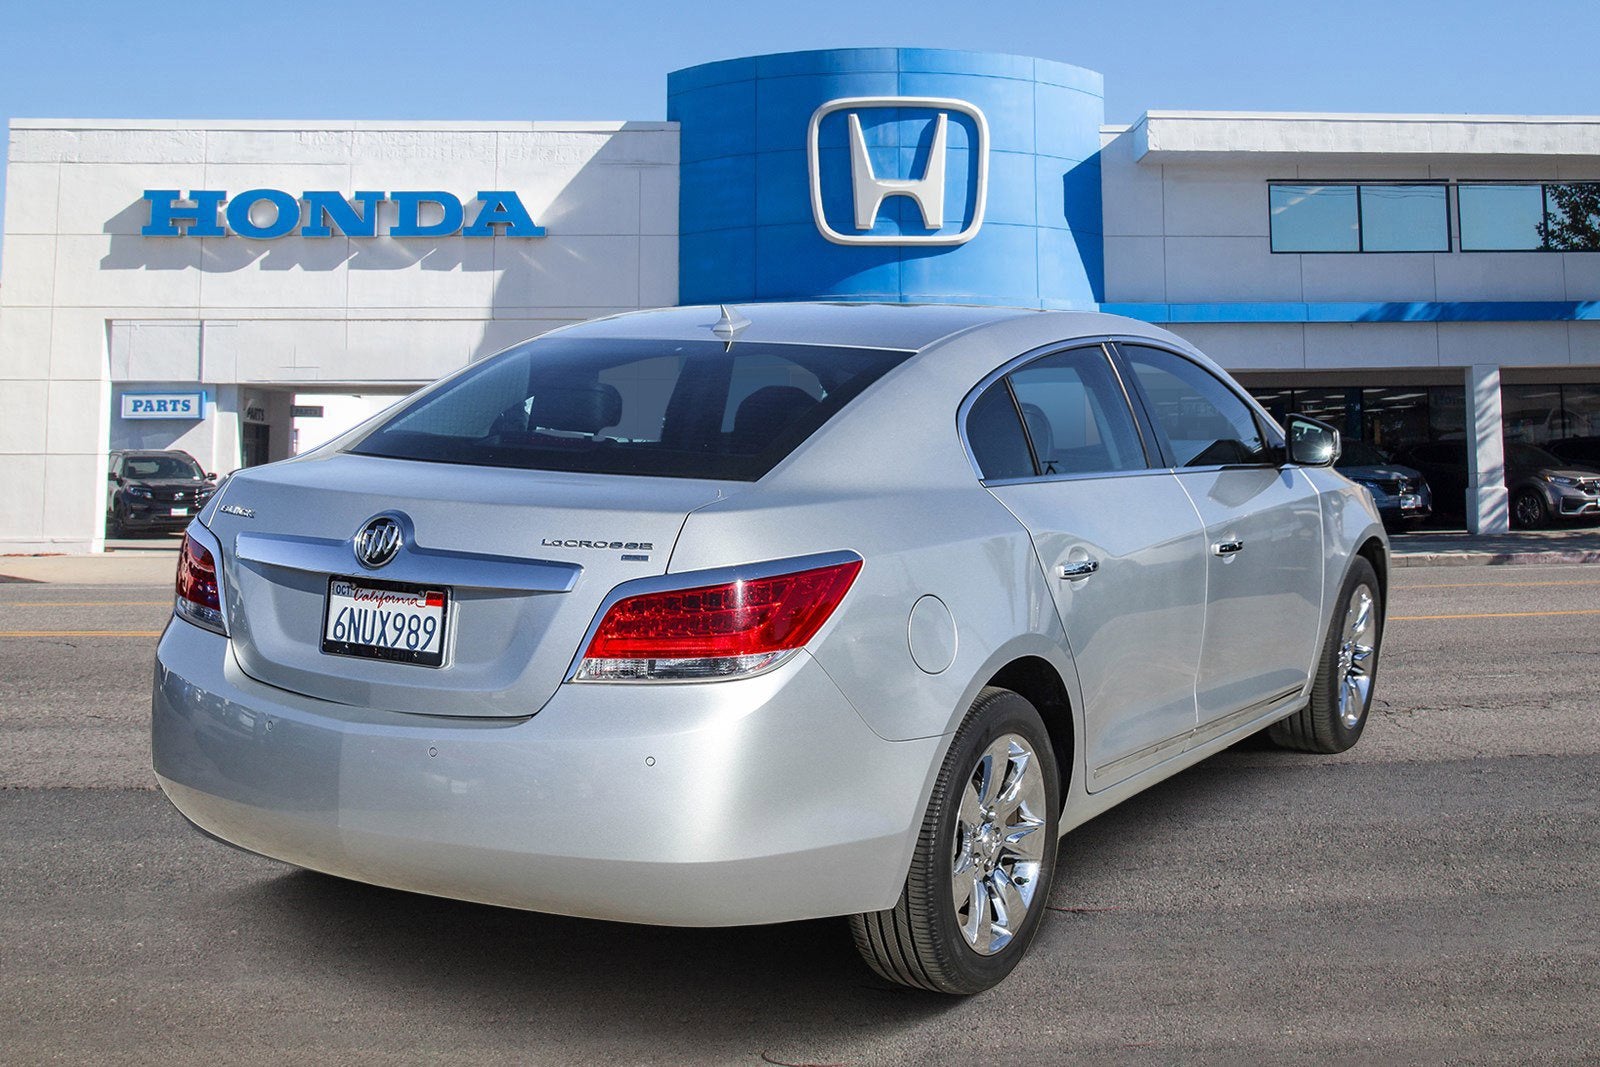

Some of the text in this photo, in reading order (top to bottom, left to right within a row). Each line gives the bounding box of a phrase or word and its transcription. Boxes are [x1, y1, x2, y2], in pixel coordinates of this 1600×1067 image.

[141, 188, 548, 240] HONDA
[131, 399, 191, 413] PARTS
[335, 584, 351, 595] OCT
[354, 587, 426, 609] California
[332, 606, 437, 652] 6NUX989
